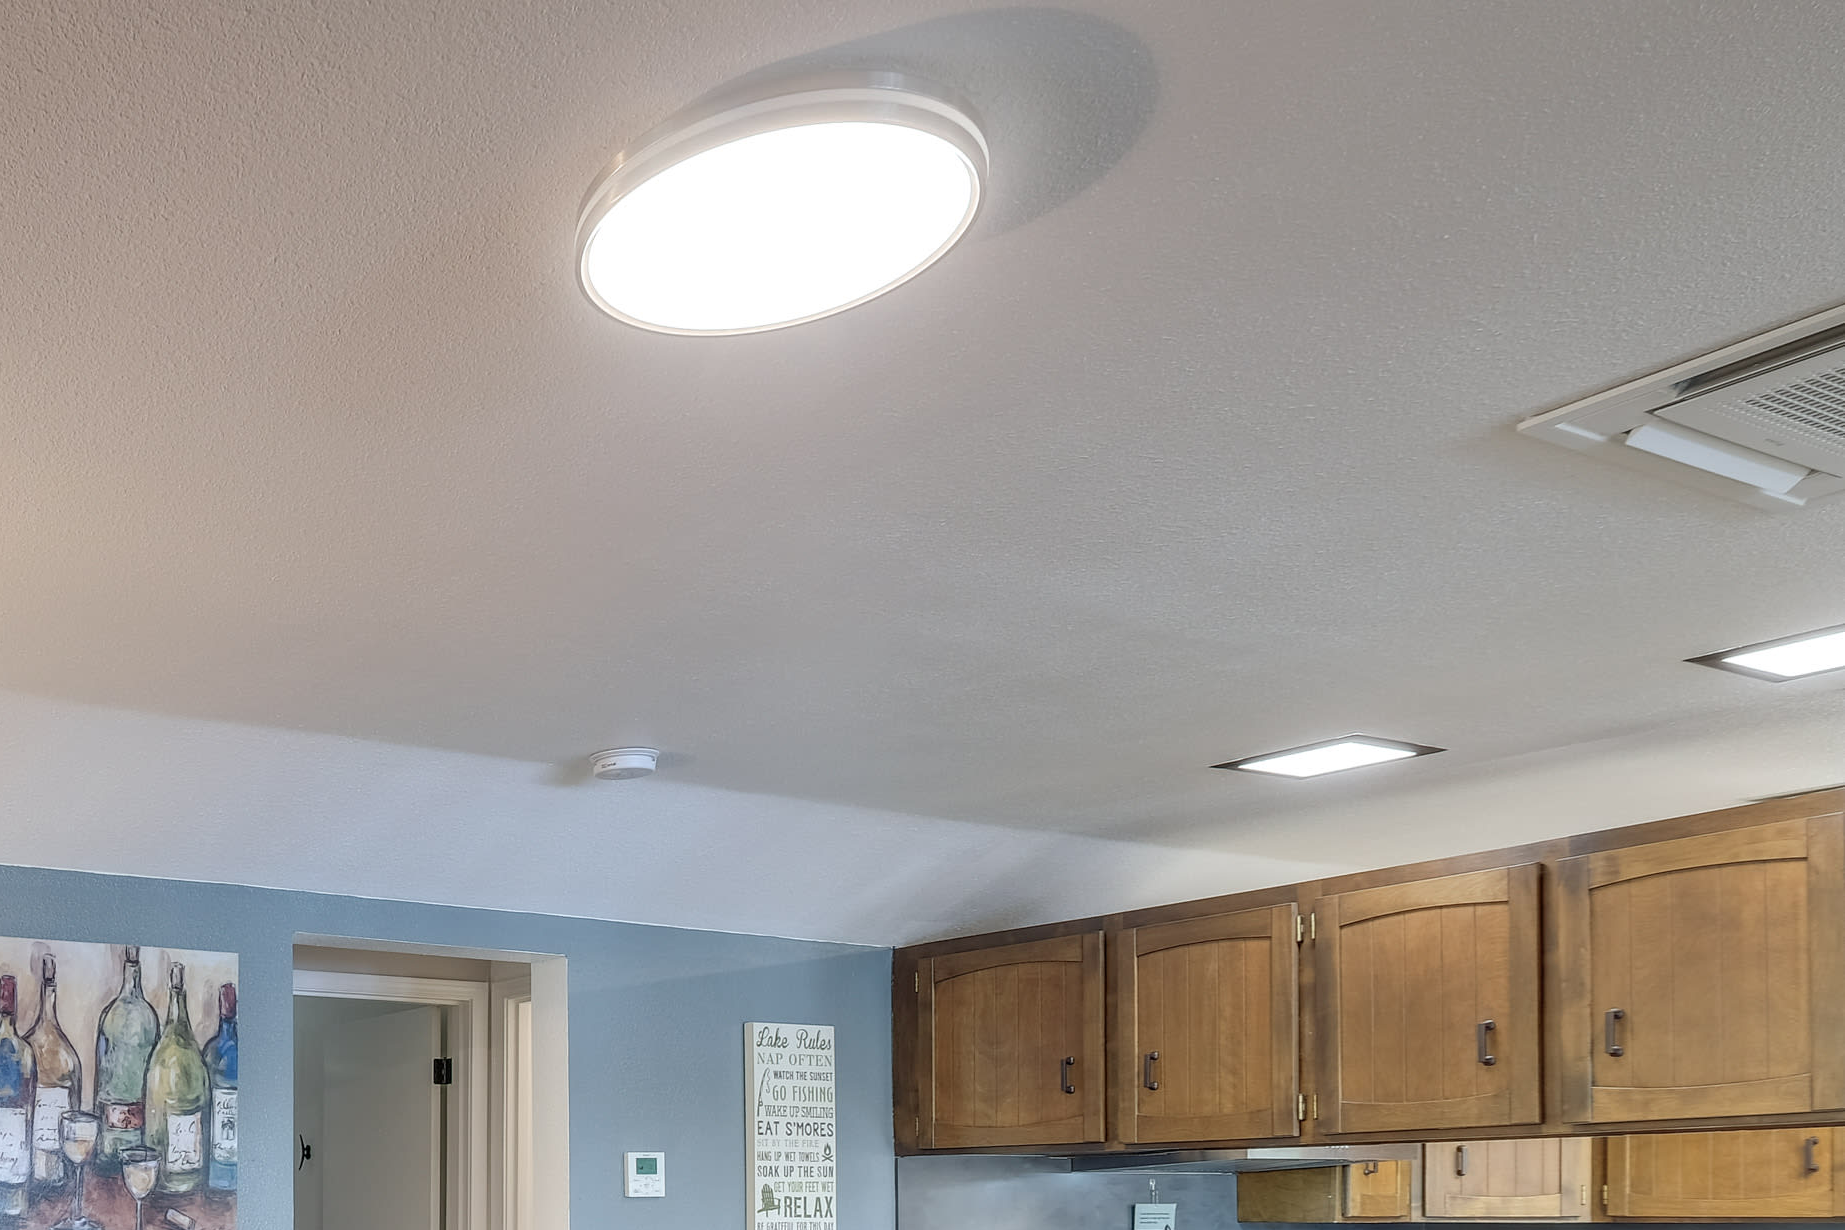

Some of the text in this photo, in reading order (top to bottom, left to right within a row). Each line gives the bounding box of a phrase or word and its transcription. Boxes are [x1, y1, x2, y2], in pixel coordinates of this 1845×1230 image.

[756, 1026, 832, 1050] Lake Rules
[757, 1052, 832, 1066] NAP OFTEN
[773, 1070, 833, 1081] WATCH THE SUNSET
[772, 1085, 833, 1102] GO FISHING
[764, 1105, 834, 1118] WAKE UP SMILING
[757, 1120, 834, 1137] EAT S'MORES
[757, 1139, 819, 1147] SIT BY THE FIRE
[757, 1151, 819, 1162] HANG UP WET TOWELS
[757, 1165, 834, 1178] SOAK UP THE SUN
[774, 1181, 834, 1192] GET YOUR FEET WET
[784, 1196, 833, 1218] RELAX
